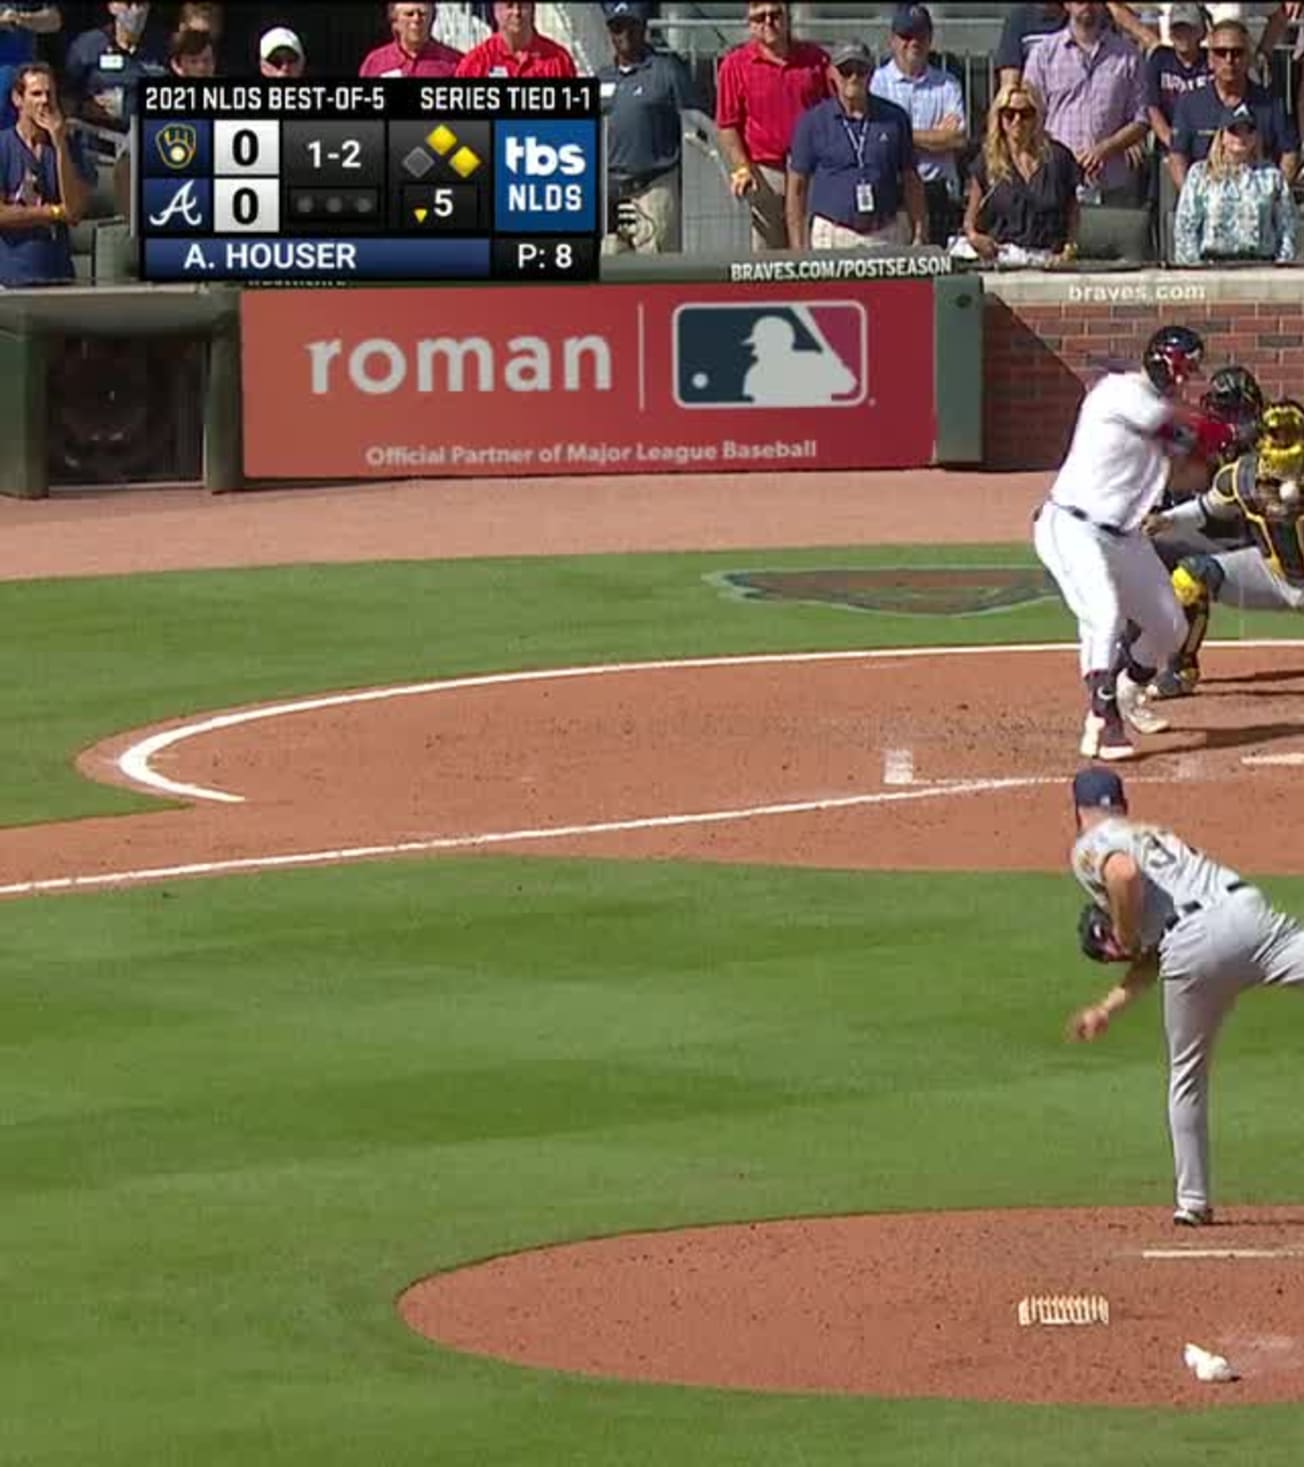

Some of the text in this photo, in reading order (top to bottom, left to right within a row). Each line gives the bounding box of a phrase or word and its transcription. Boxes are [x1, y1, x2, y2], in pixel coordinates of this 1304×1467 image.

[730, 256, 951, 281] BRAVES.COM/POSTSEASON
[1068, 283, 1206, 301] braves.com
[305, 333, 612, 394] roman
[365, 439, 818, 466] Official Partner of Major League Baseball
